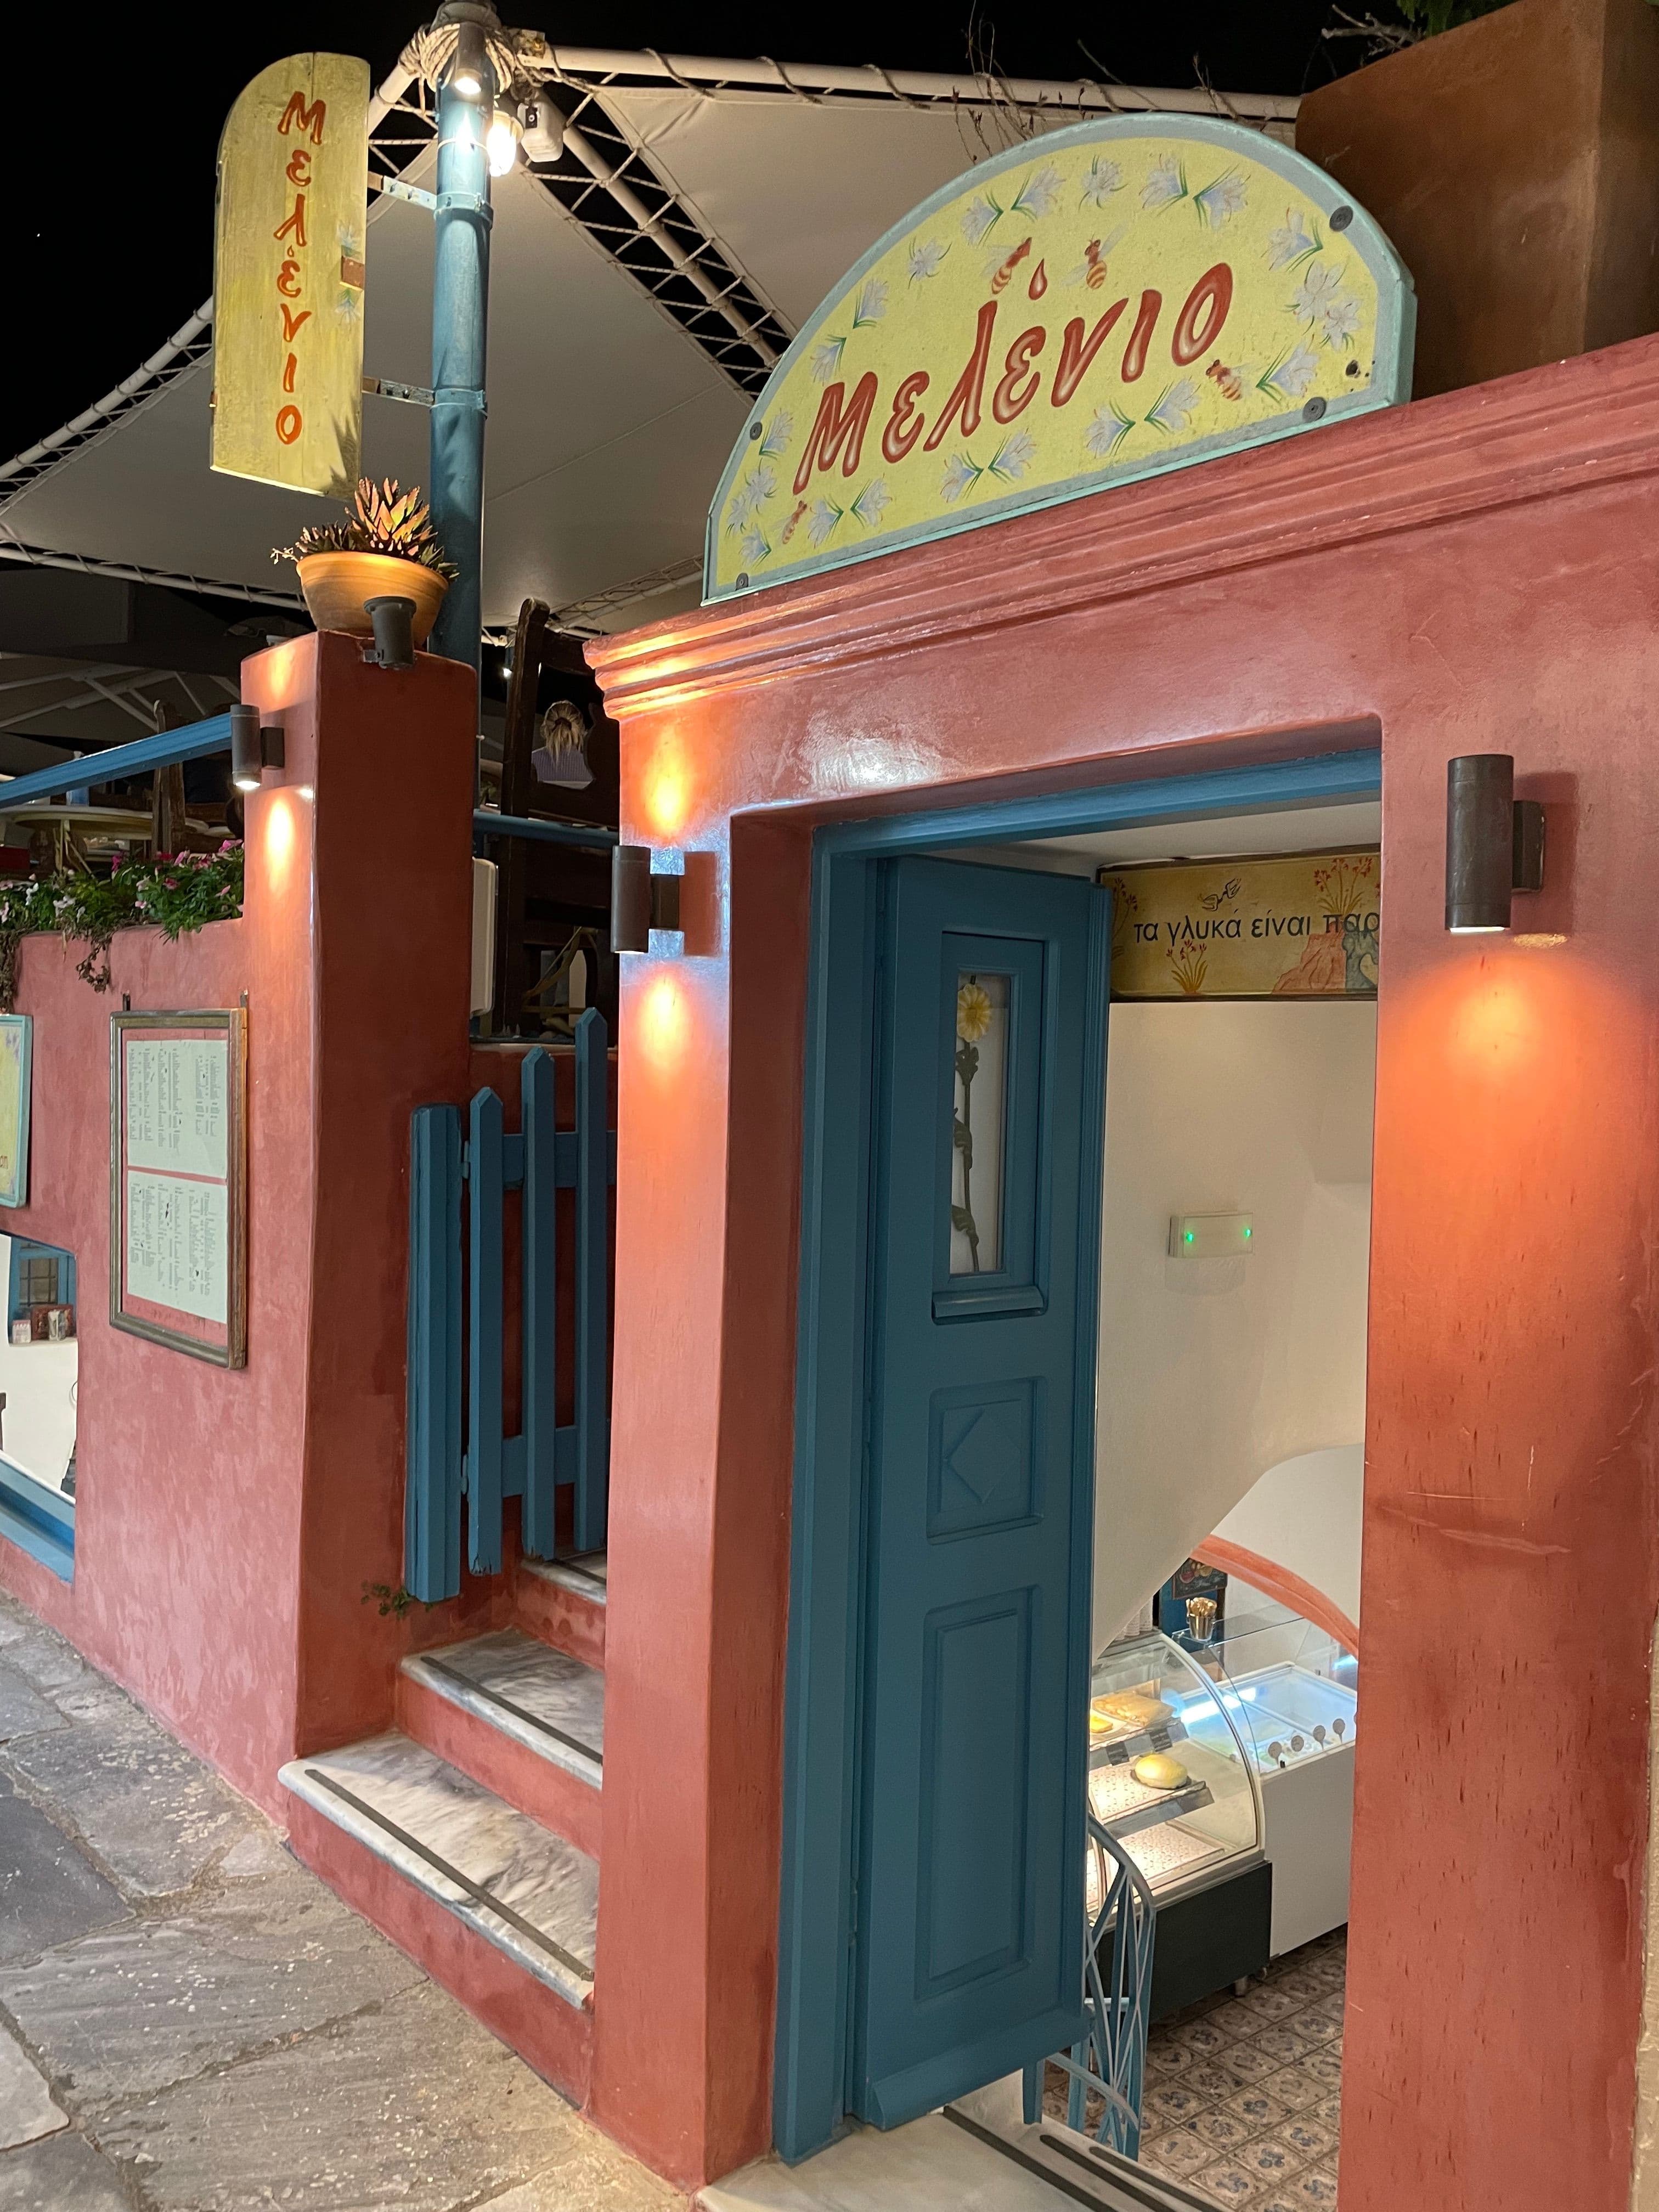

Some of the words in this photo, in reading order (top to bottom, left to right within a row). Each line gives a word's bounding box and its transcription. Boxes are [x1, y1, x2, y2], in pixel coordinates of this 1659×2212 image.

[793, 258, 1234, 495] Μελένιο
[1133, 922, 1159, 943] τα
[1167, 908, 1241, 946] γλυκά
[1251, 909, 1311, 939] είναι
